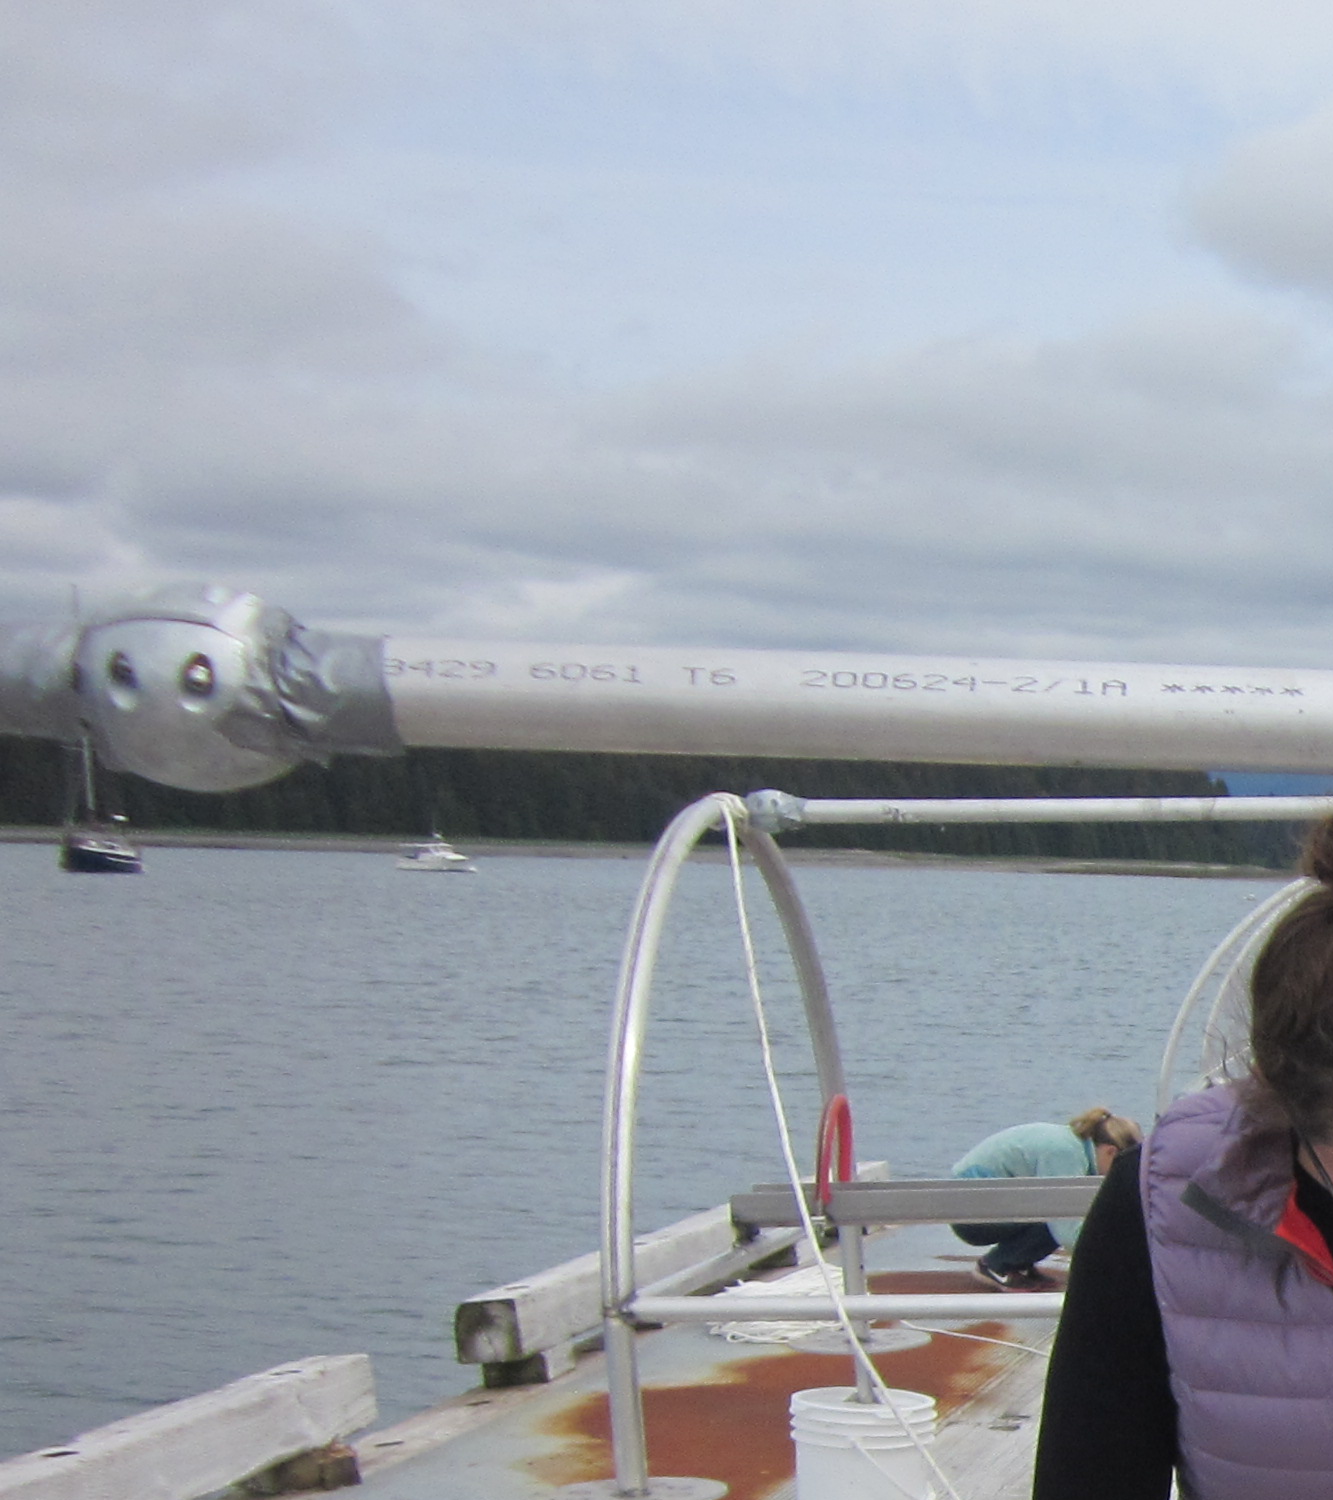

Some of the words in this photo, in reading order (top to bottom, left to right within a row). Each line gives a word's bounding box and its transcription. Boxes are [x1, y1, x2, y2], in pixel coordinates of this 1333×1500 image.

[529, 661, 642, 684] 6061
[682, 665, 736, 686] T6
[799, 669, 1127, 697] 200624-2/1A
